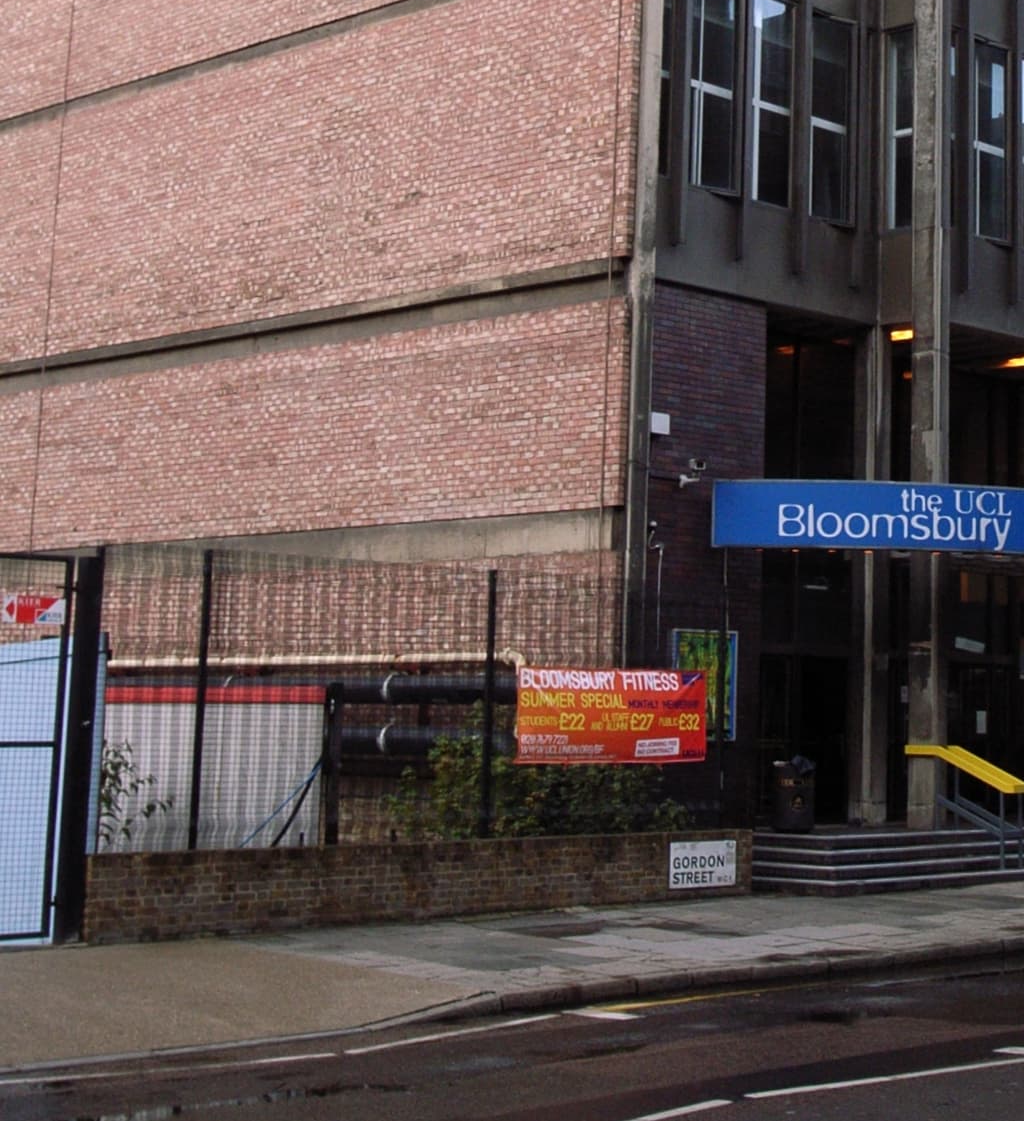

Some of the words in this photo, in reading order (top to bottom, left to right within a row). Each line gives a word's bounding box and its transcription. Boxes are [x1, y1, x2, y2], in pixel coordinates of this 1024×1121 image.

[901, 489, 942, 512] the
[953, 490, 1012, 516] UCL
[778, 503, 1011, 551] Bloomsbury
[520, 668, 616, 691] BLOOMSBURY
[620, 671, 679, 691] FITNESS
[521, 691, 576, 708] SUMMER
[580, 693, 628, 709] SPECIAL
[559, 712, 585, 731] £22
[630, 712, 655, 732] £27
[679, 712, 701, 731] £32
[673, 855, 725, 870] GORDON
[672, 871, 715, 885] STREET
